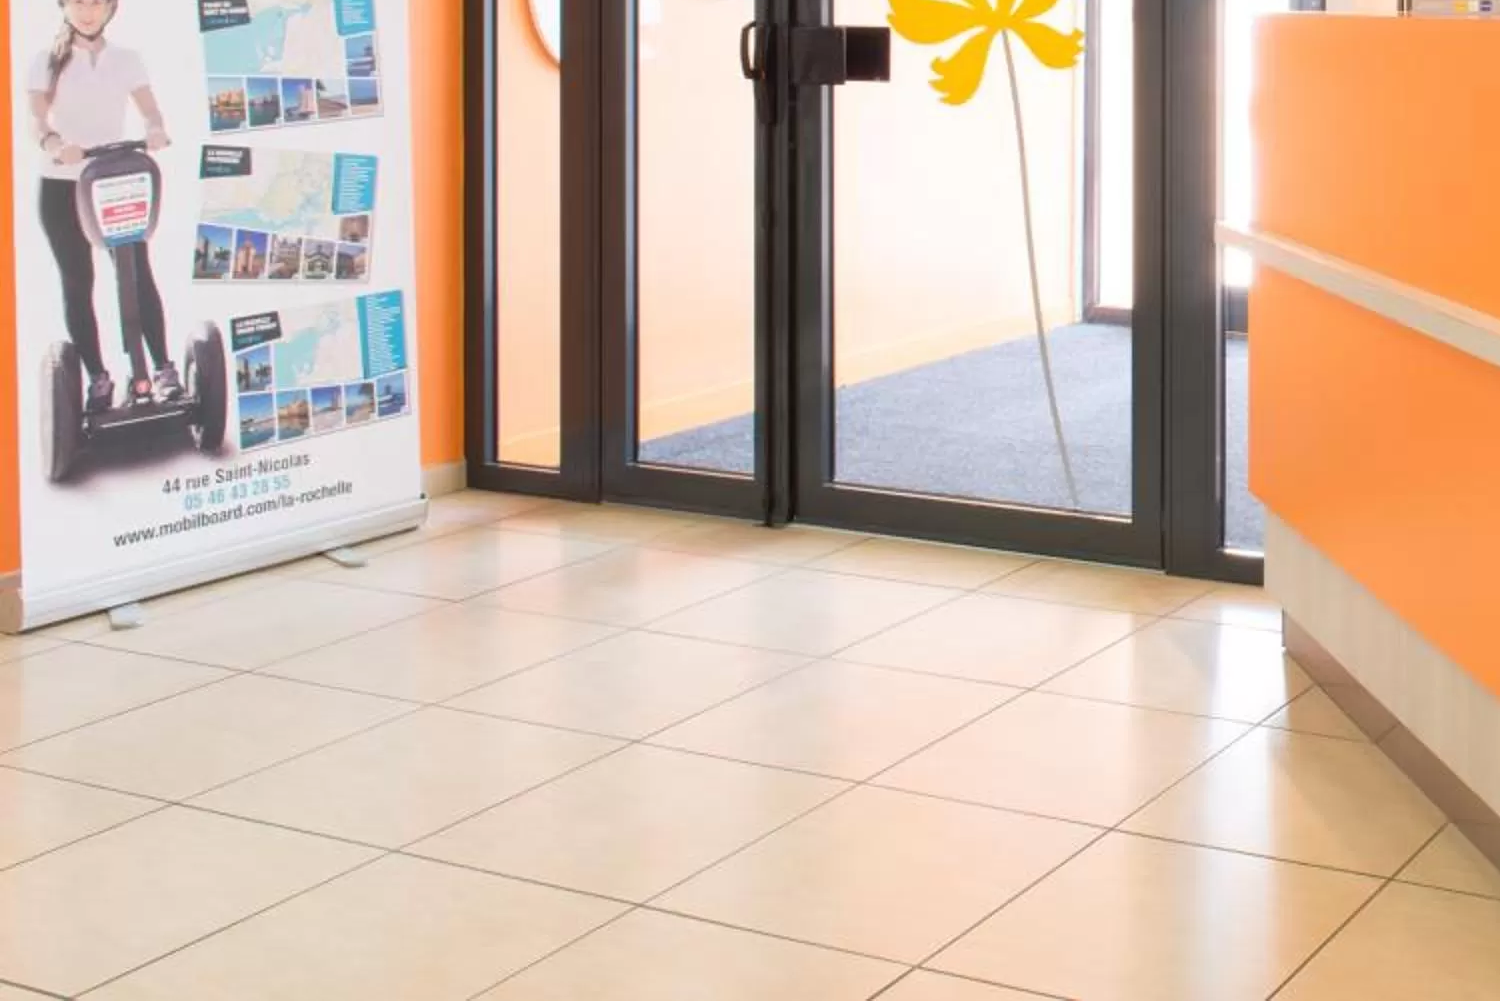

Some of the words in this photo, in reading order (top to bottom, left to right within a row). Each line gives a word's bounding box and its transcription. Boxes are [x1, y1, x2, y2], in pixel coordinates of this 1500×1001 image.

[162, 477, 182, 495] 44
[185, 473, 210, 492] rue
[215, 452, 311, 485] Saint-Nicolas
[113, 480, 353, 548] www.mobilboard.com/la-rochelle
